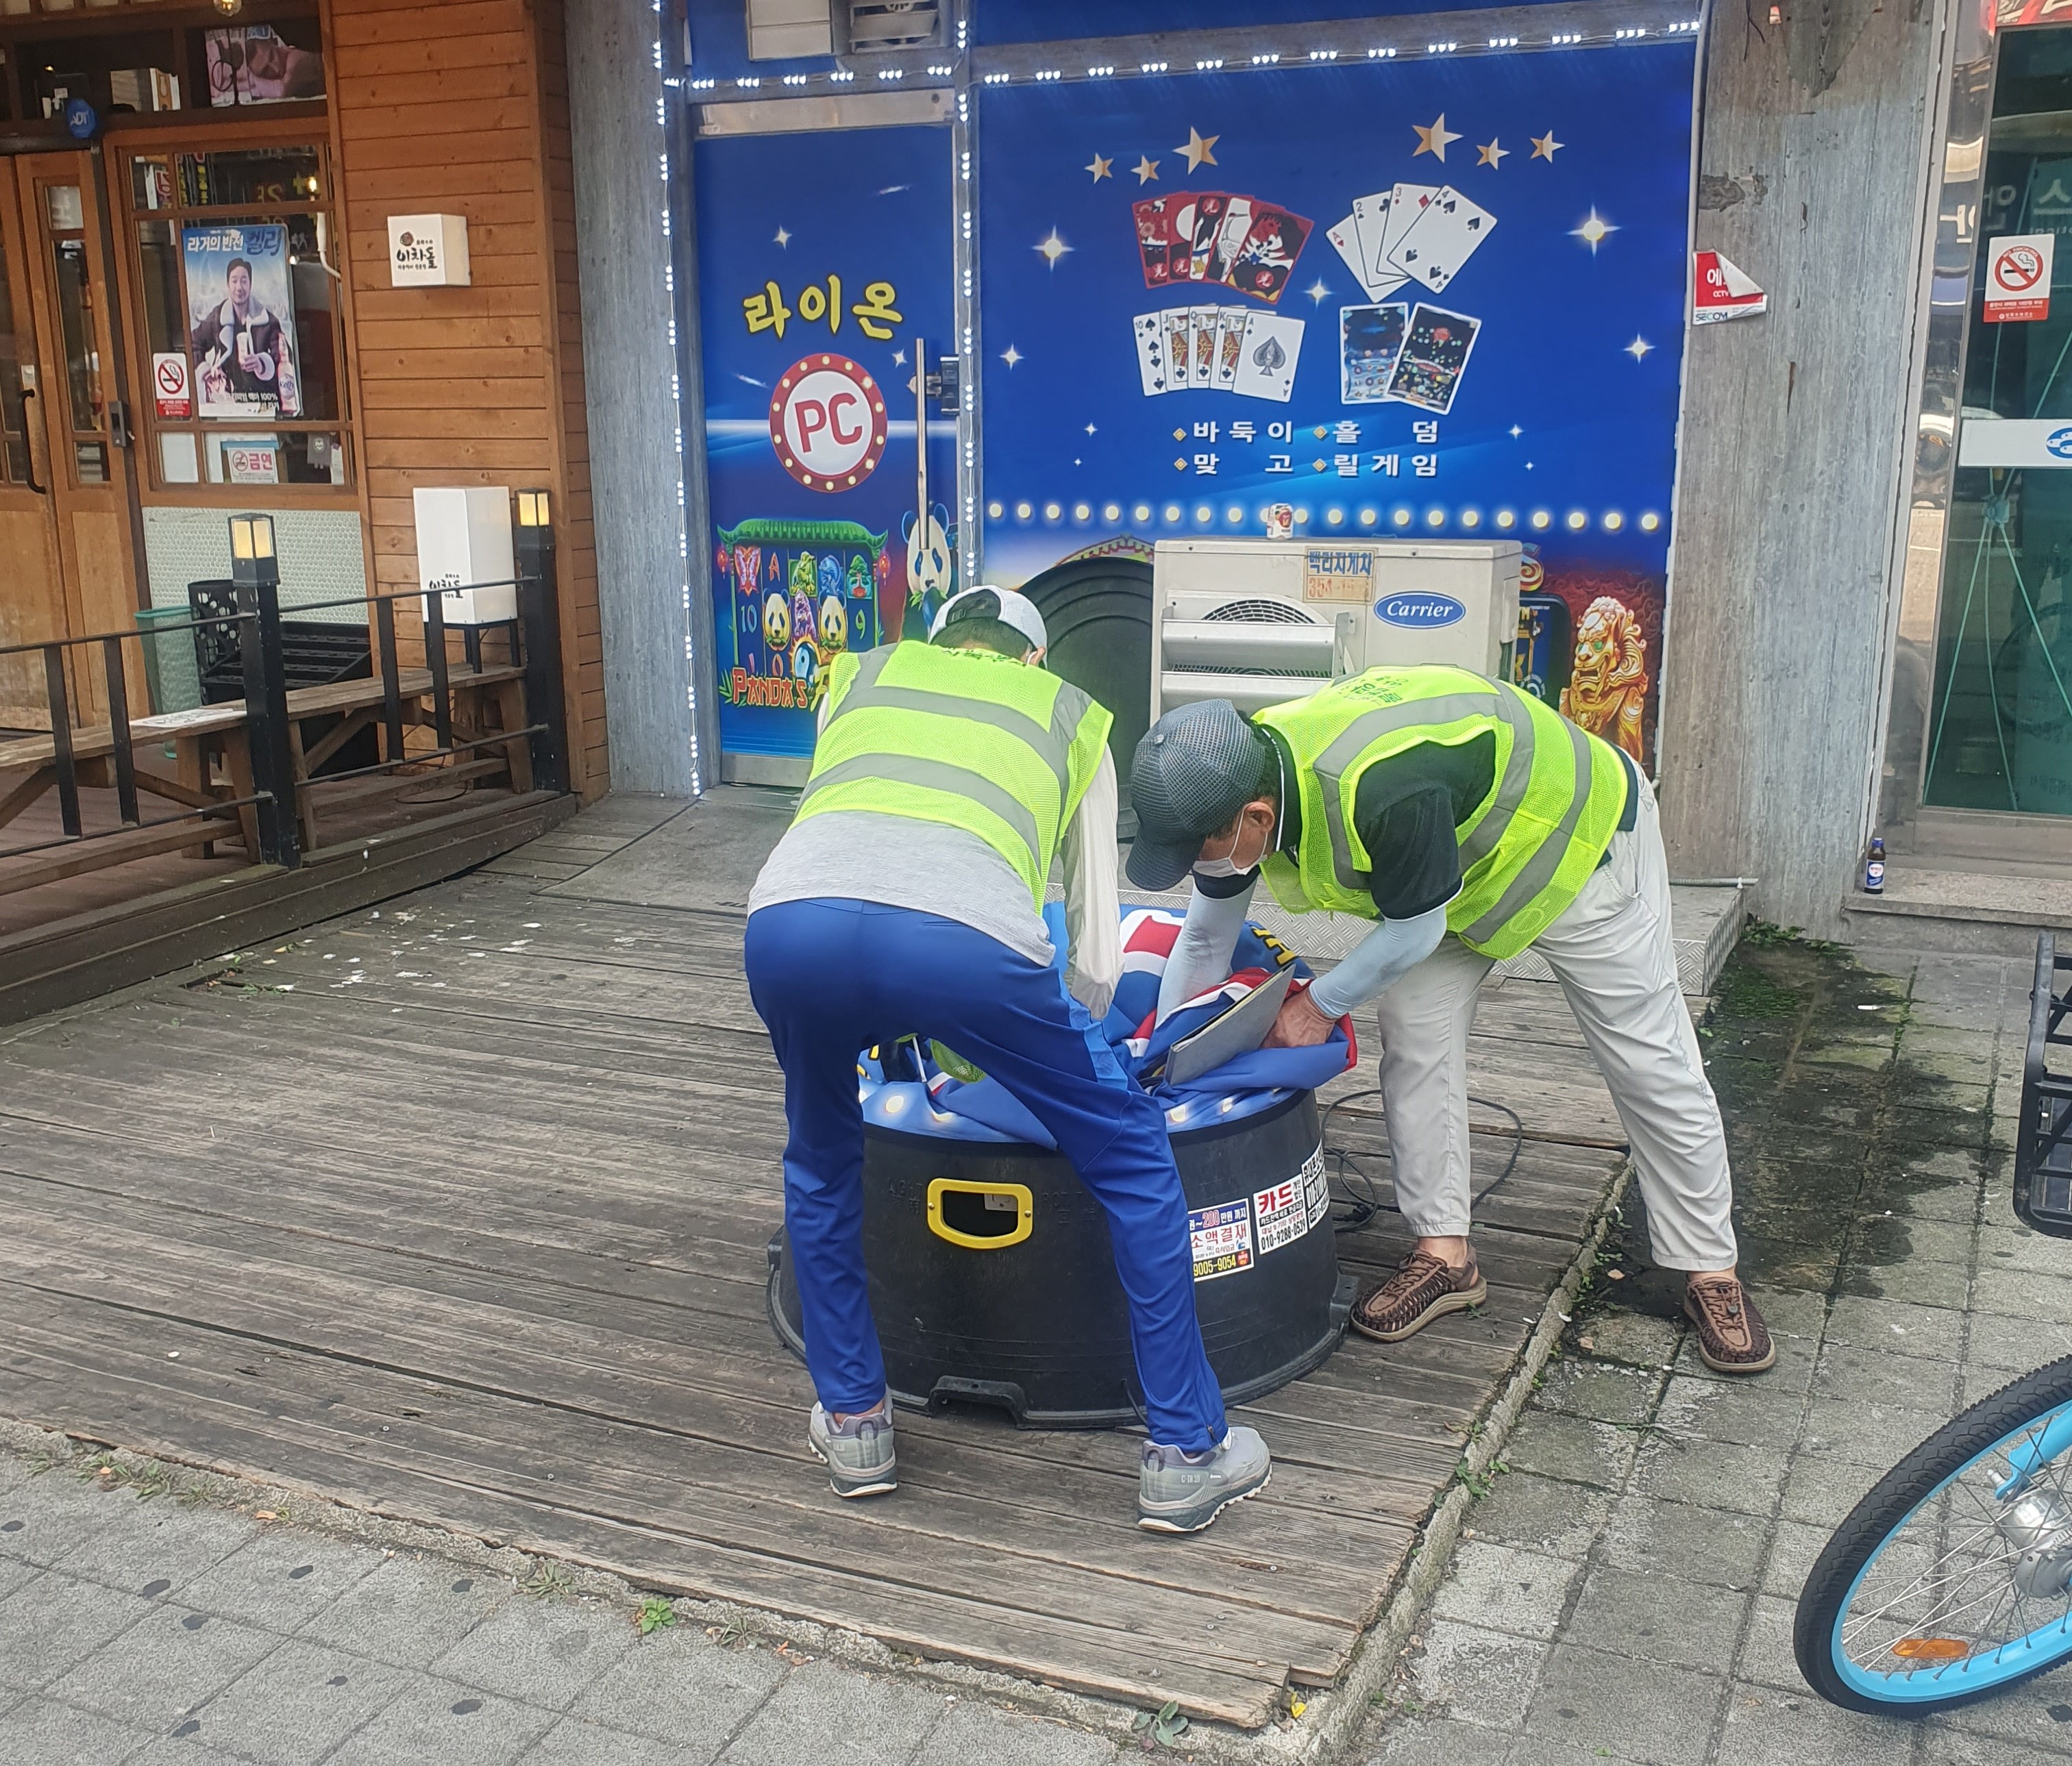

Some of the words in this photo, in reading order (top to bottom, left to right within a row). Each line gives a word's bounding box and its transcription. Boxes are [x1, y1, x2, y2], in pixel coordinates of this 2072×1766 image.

[1395, 187, 1403, 197] 3
[1356, 201, 1364, 212] 2
[187, 236, 220, 253] 라거의
[396, 247, 438, 269] 이차돌
[1707, 268, 1727, 286] 에
[1713, 290, 1729, 298] CCTV
[743, 274, 903, 340] 라이온
[1135, 321, 1144, 330] 10
[1696, 312, 1727, 322] SECOM
[795, 393, 863, 453] PC
[1193, 421, 1292, 443] 바둑이
[248, 452, 273, 471] 금연
[1333, 453, 1438, 477] 릴게임
[1386, 600, 1453, 618] Carrier
[741, 604, 758, 634] 10
[1258, 1183, 1294, 1215] 카드
[1192, 1223, 1247, 1249] 소액결재
